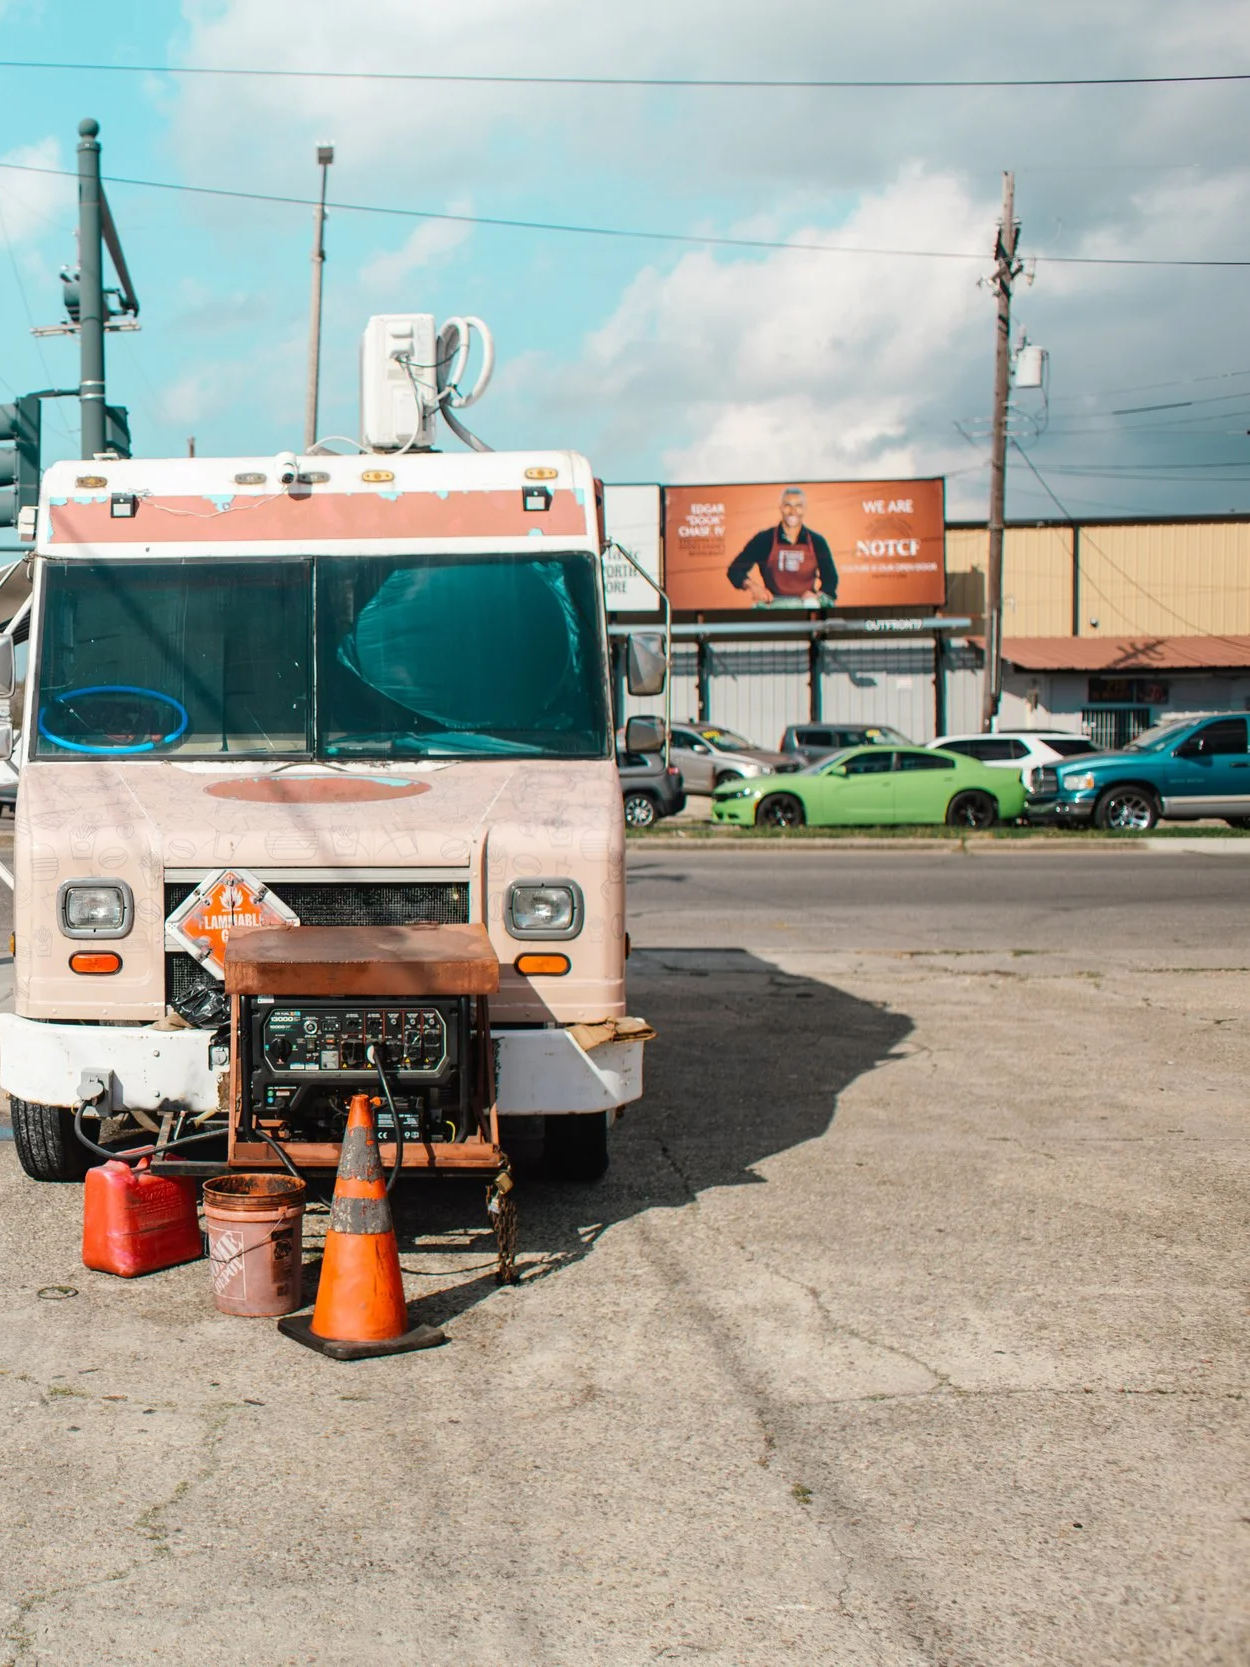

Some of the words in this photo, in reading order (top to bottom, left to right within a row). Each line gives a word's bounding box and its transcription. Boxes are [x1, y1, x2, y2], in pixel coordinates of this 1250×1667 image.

[862, 499, 886, 514] WE
[887, 499, 914, 513] ARE
[605, 562, 638, 579] ORTH
[605, 580, 628, 594] ORE
